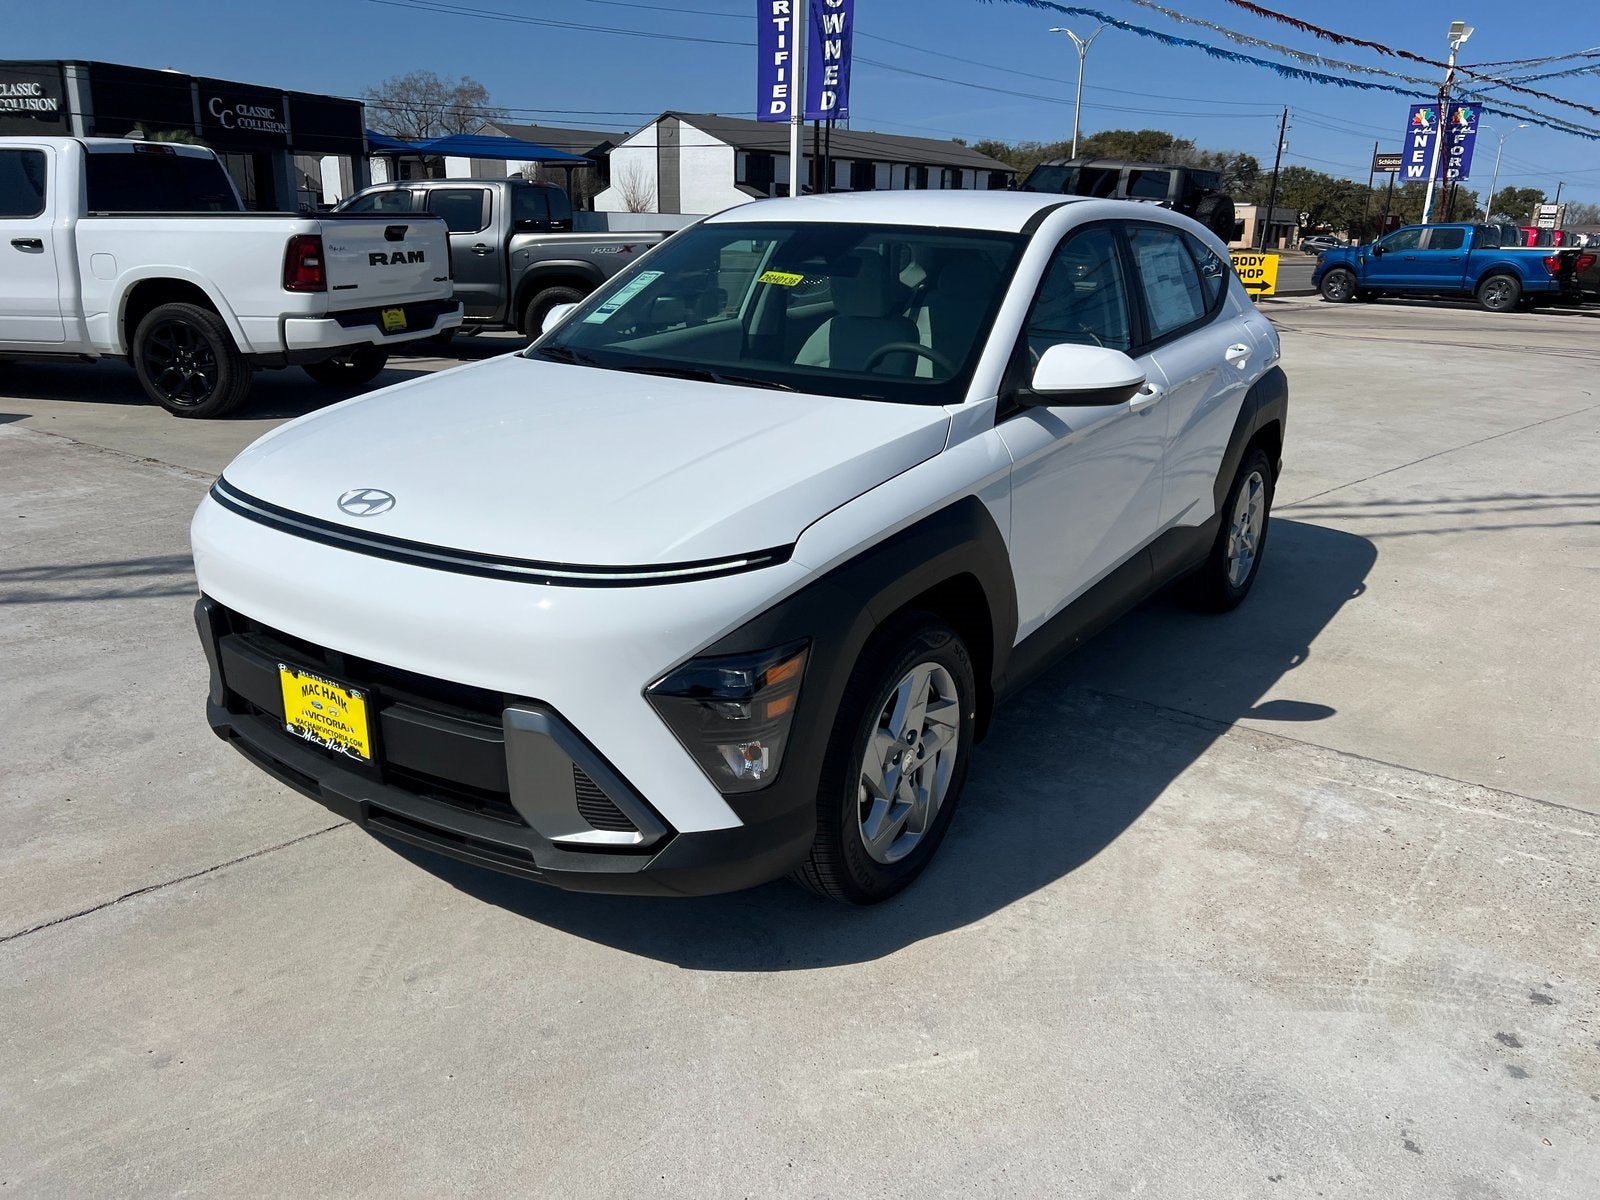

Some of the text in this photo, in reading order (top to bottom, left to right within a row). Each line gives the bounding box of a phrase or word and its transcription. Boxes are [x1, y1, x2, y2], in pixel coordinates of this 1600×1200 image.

[235, 104, 275, 120] CLASSIC
[237, 117, 288, 134] COLLISION
[1407, 135, 1428, 178] NEW
[1447, 134, 1466, 178] FORD
[368, 250, 425, 267] RAM
[1232, 256, 1266, 267] BODY
[301, 683, 349, 714] MAC HAIK
[307, 709, 348, 733] VICTORIA
